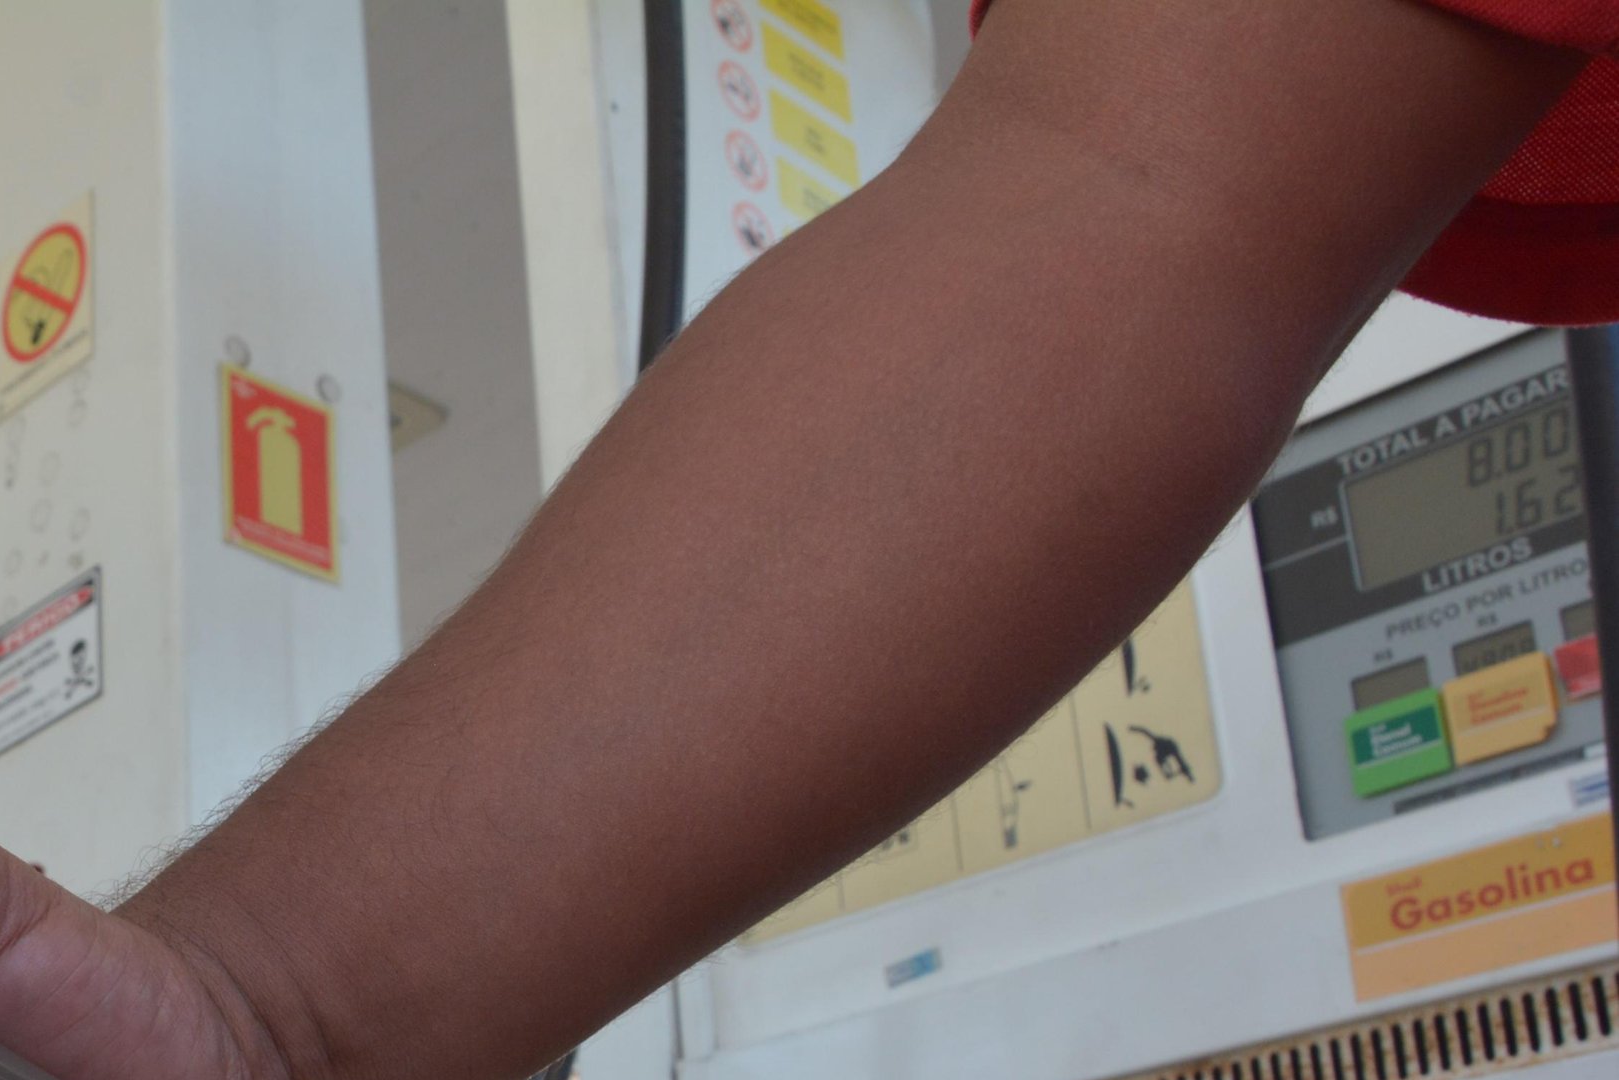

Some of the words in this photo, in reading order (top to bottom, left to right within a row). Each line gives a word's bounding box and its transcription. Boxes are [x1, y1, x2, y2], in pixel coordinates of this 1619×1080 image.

[1335, 427, 1428, 476] TOTAL
[1434, 415, 1457, 439] A
[1460, 366, 1570, 428] PAGAR
[1310, 506, 1339, 529] R$
[1386, 603, 1461, 640] PREÇO
[1466, 583, 1515, 617] POR
[1517, 557, 1588, 595] LITRO
[1422, 536, 1532, 594] LITROS
[1390, 857, 1595, 932] Gasolina
